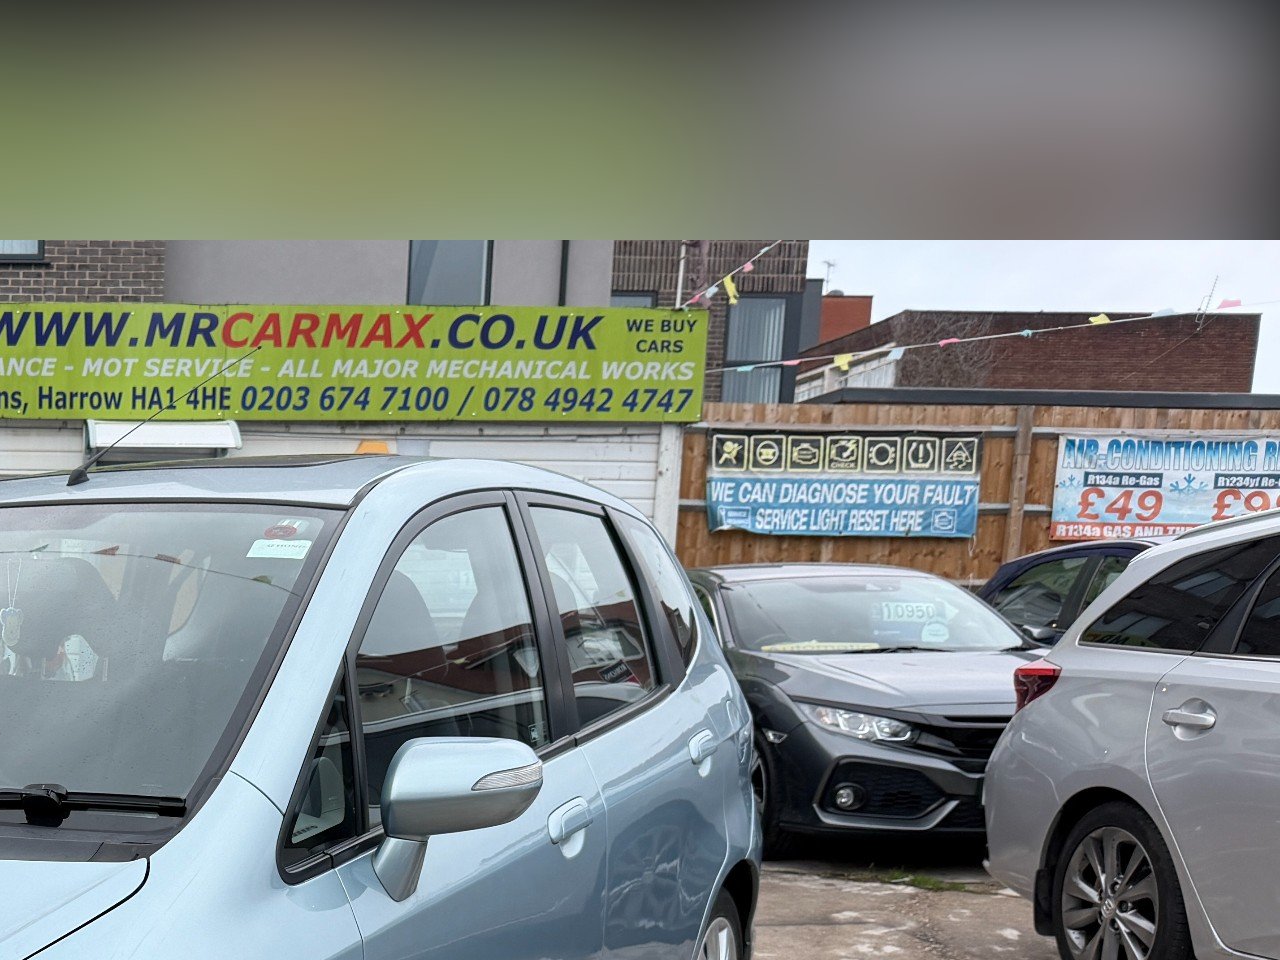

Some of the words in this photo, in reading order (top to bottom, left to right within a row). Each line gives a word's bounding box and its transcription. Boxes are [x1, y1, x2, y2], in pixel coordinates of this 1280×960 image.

[626, 318, 656, 333] WE
[660, 318, 697, 334] BUY
[635, 339, 684, 354] CARS
[81, 358, 139, 378] MOT
[143, 358, 252, 379] SERVICE
[276, 359, 323, 379] ALL
[331, 359, 419, 379] MAJOR
[425, 359, 592, 380] MECHANICAL
[602, 361, 696, 381] WORKS
[37, 386, 123, 411] Harrow
[131, 387, 176, 412] HA1
[185, 387, 231, 412] 4HE
[240, 386, 310, 412] 0203
[319, 386, 370, 412] 674
[381, 387, 449, 412] 7100
[484, 387, 535, 412] 078
[543, 388, 614, 413] 4942
[622, 388, 694, 413] 4747
[1061, 438, 1259, 472] AIR-CONDITIONING
[1263, 441, 1280, 472] R
[1087, 473, 1120, 486] R134a
[1121, 475, 1161, 487] Re-Gas
[1261, 477, 1280, 487] Re-
[711, 482, 736, 500] WE
[738, 482, 776, 503] CAN
[779, 482, 869, 505] DIAGNOSE
[873, 484, 920, 505] YOUR
[922, 484, 974, 505] FAULT
[1076, 487, 1164, 522] £49
[1211, 488, 1280, 522] £9
[754, 509, 807, 531] SERVICE
[809, 510, 847, 532] LIGHT
[848, 510, 889, 532] RESET
[889, 511, 925, 532] HERE
[1055, 524, 1101, 538] R134a
[1102, 525, 1132, 538] GAS
[1134, 526, 1164, 538] AND
[884, 603, 936, 620] 10950
